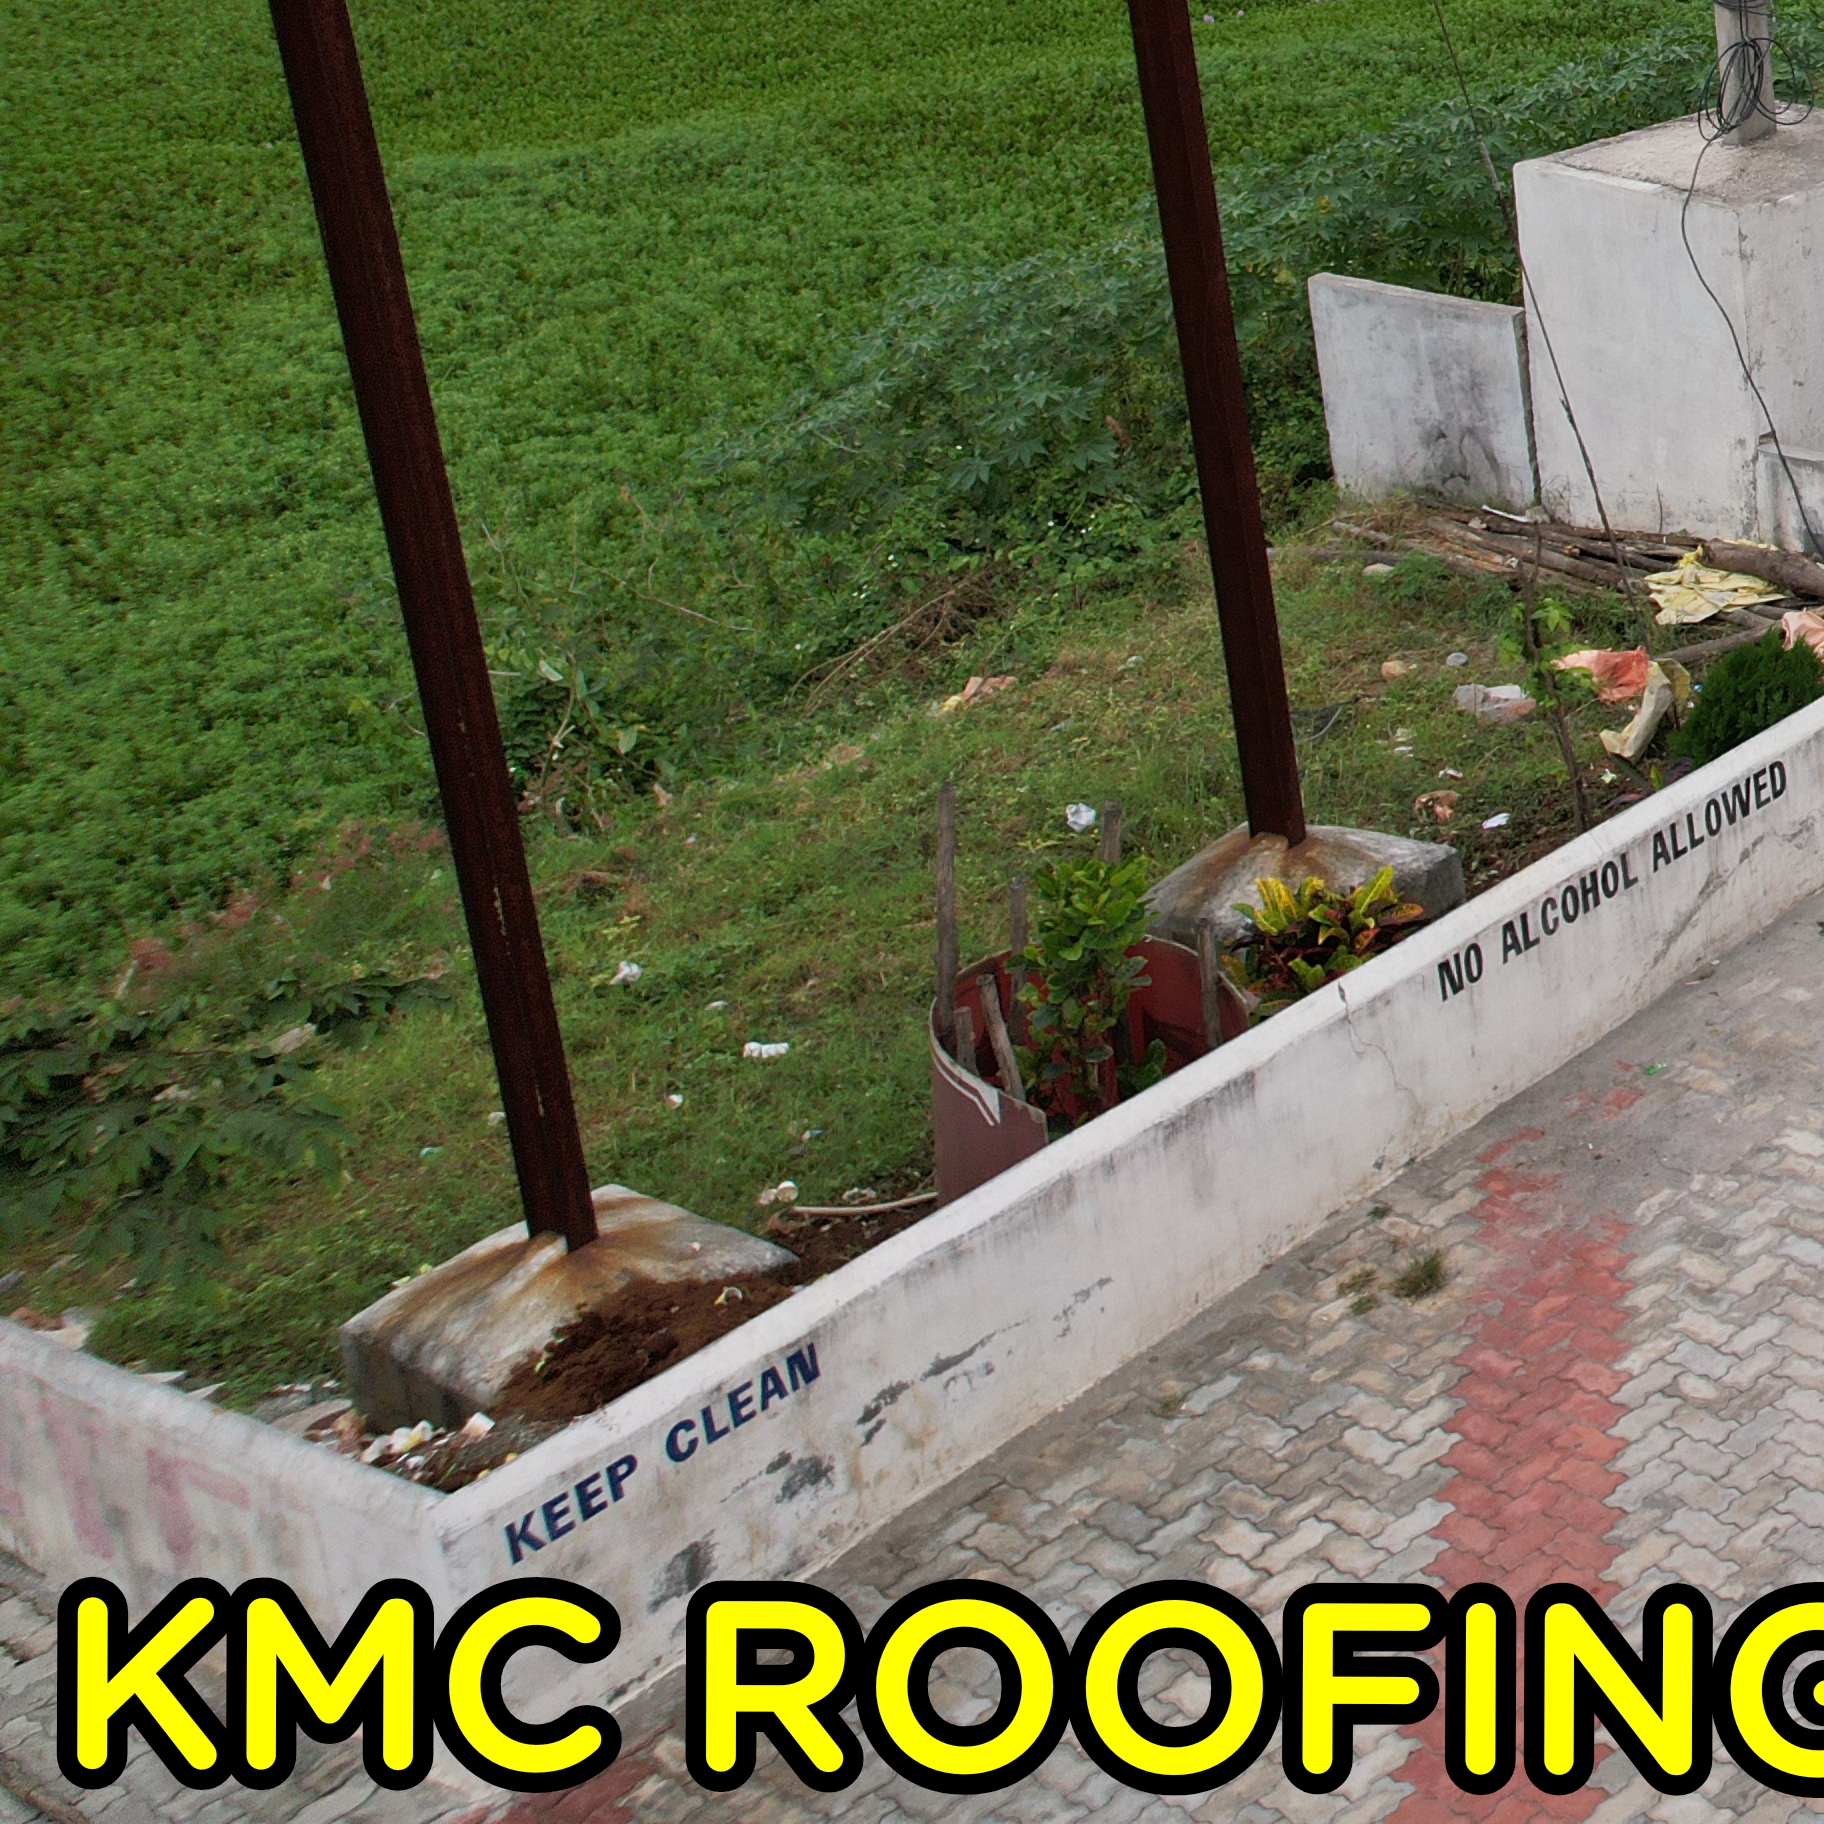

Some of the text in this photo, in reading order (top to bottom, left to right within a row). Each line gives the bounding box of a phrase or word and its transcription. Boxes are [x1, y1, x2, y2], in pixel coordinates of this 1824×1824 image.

[1436, 759, 1788, 1001] NO ALCOHOL ALLOWED
[504, 1341, 823, 1566] KEEP CLEAN
